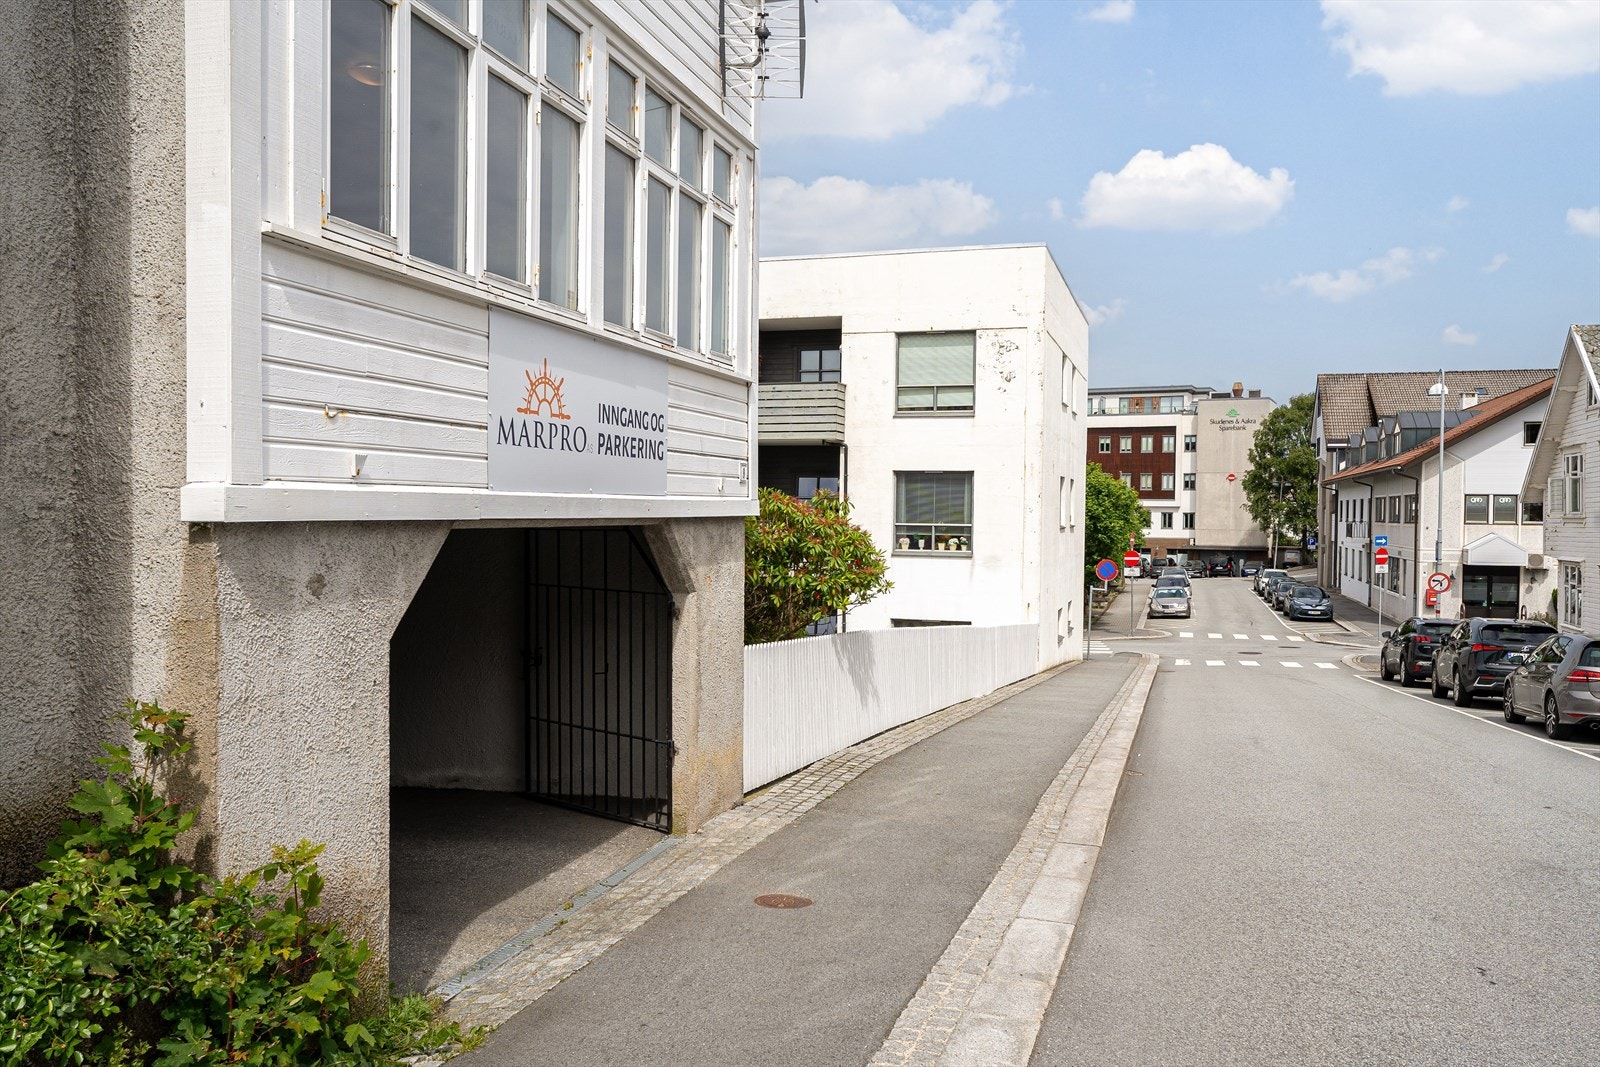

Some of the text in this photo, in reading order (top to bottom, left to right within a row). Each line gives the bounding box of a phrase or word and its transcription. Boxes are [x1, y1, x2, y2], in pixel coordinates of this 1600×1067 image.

[598, 403, 664, 433] INNGANG OG
[496, 415, 587, 453] MARPRO
[597, 432, 664, 461] PARKERING
